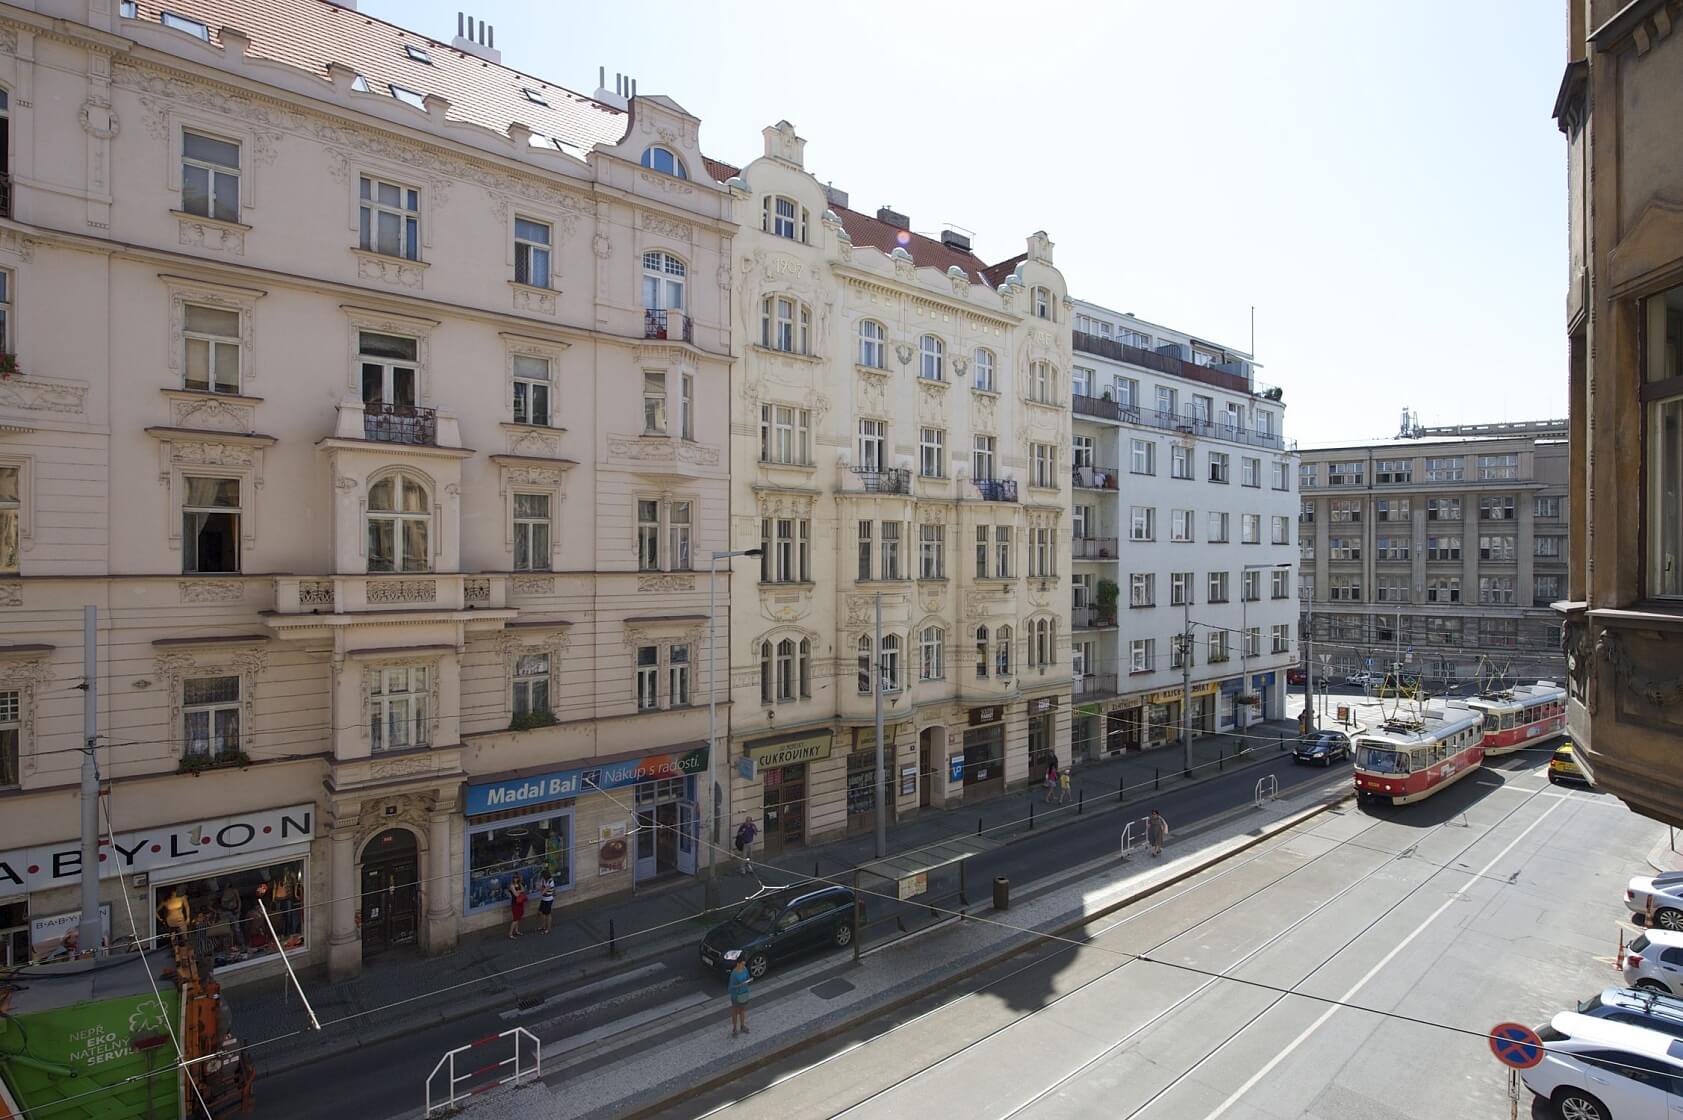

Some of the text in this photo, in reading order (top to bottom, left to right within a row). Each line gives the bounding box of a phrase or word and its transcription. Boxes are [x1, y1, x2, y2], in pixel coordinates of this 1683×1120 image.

[760, 746, 820, 766] CUKROVINKY
[487, 780, 545, 806] Madal
[549, 776, 577, 795] Bal
[648, 765, 655, 776] s
[87, 1033, 116, 1048] EKO
